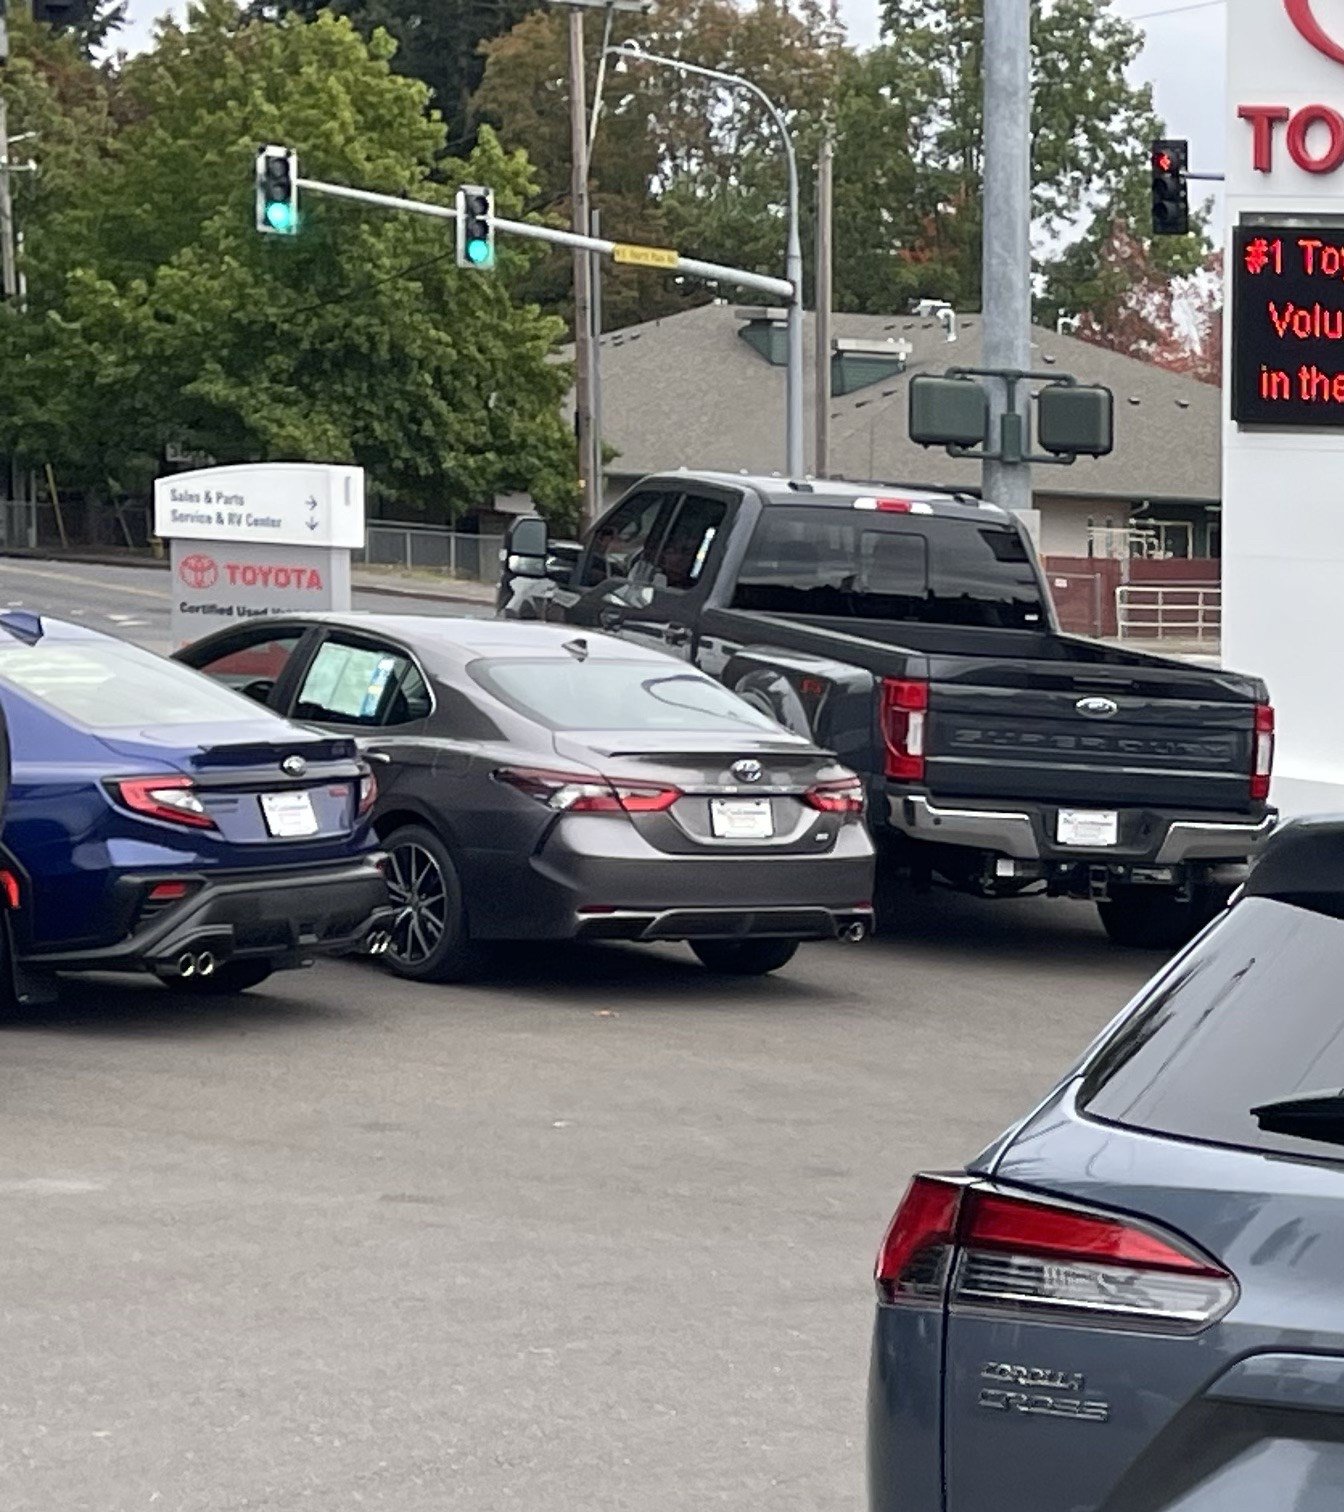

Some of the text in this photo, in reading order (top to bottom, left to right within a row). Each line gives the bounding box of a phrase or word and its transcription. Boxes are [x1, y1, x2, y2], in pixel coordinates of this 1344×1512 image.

[1244, 237, 1283, 275] #1
[1260, 364, 1291, 401] in
[170, 489, 245, 506] Sales & Parts
[171, 509, 281, 528] Service & RV Center
[225, 564, 323, 591] TOYOTA
[180, 601, 233, 616] Certified
[978, 1388, 1110, 1422] CROSS
